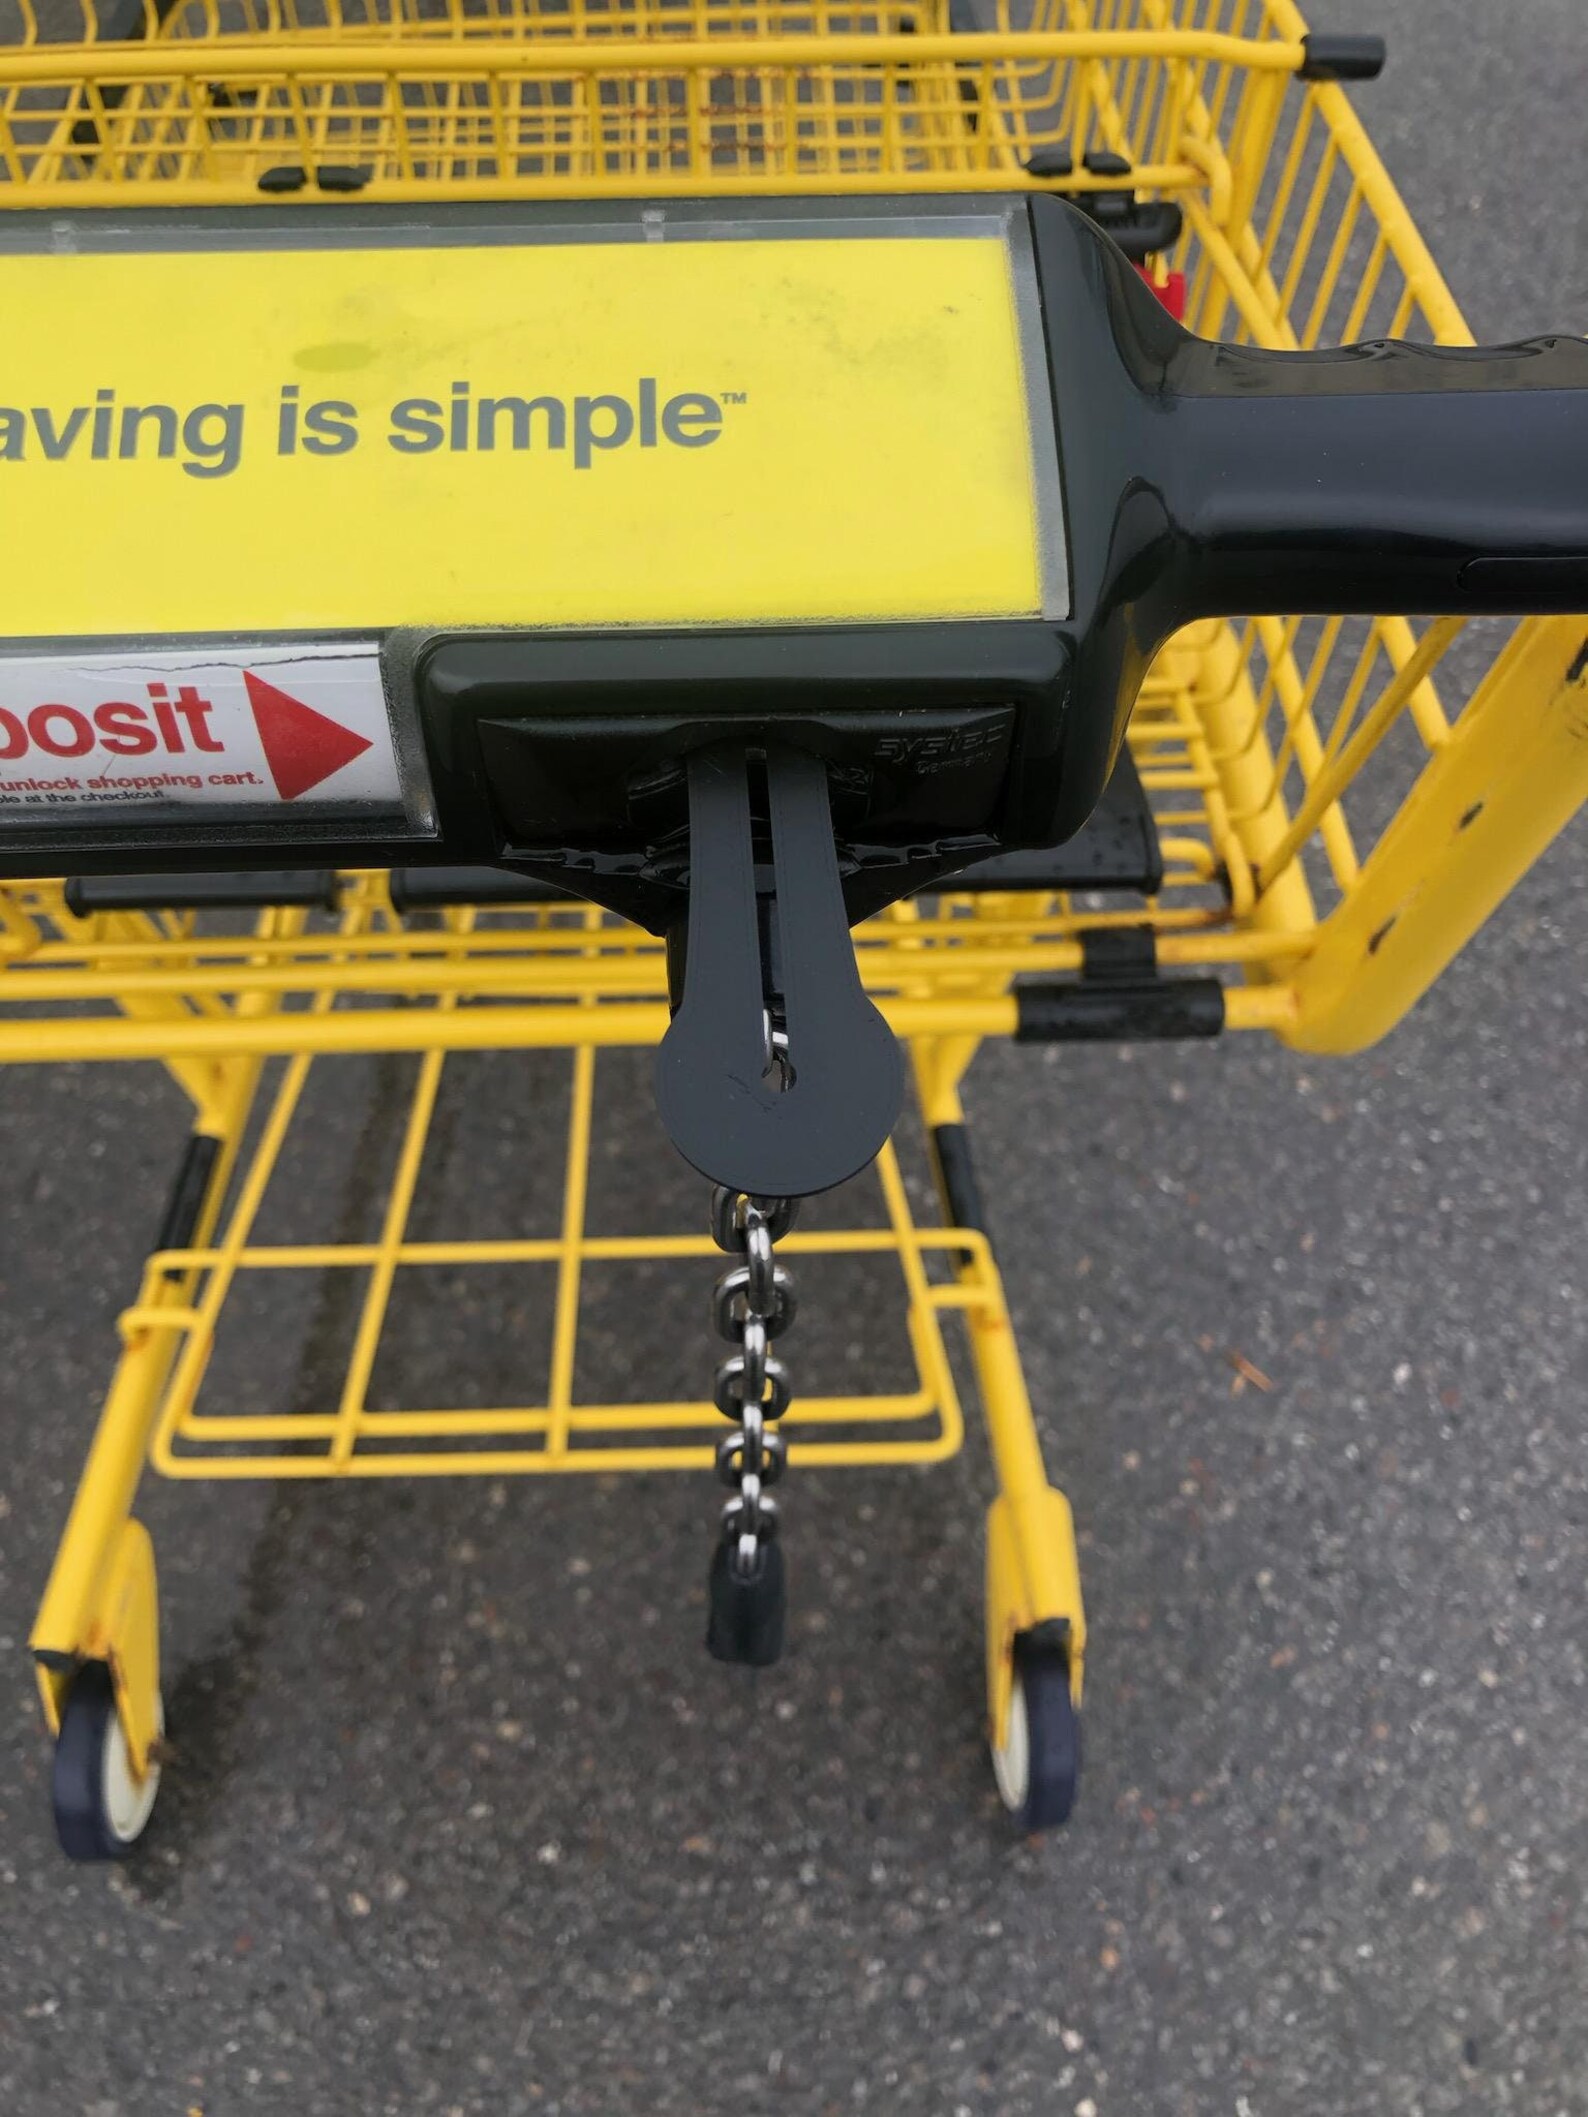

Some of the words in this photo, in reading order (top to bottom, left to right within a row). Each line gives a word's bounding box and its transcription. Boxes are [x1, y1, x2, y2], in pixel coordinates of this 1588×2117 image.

[278, 385, 359, 455] is
[0, 777, 82, 792] unlock
[86, 773, 203, 790] shopping
[25, 794, 45, 803] at
[46, 792, 77, 802] the
